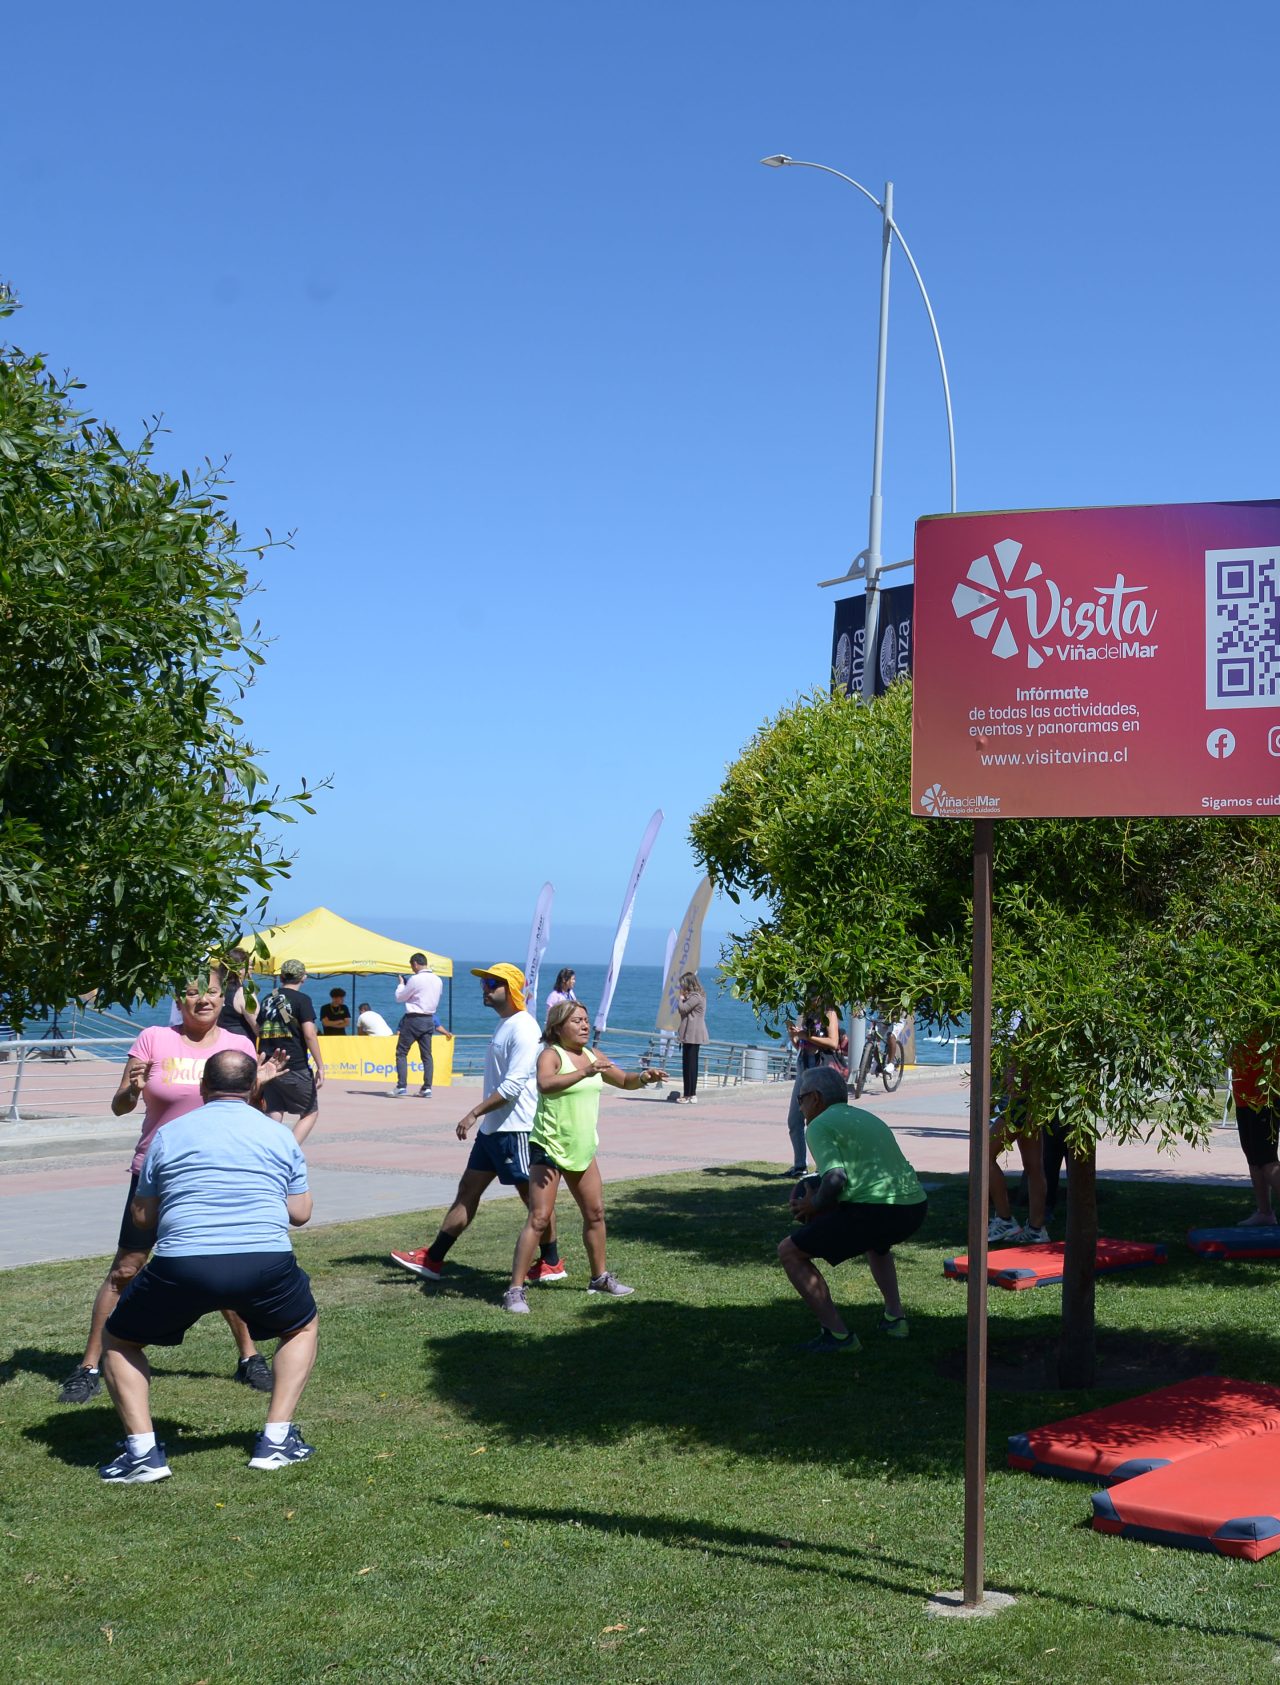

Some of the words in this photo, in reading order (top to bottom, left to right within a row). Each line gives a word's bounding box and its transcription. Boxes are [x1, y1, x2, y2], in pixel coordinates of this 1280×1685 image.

[1004, 573, 1158, 640] Visita
[1056, 641, 1158, 661] ViñadelMar
[851, 627, 865, 708] anza
[1016, 685, 1089, 702] Infórmate
[969, 707, 986, 721] de
[989, 705, 1027, 720] todas
[1031, 704, 1050, 718] las
[1053, 702, 1140, 718] actividades,
[969, 722, 1023, 736] eventos
[1026, 724, 1034, 737] y
[1037, 720, 1119, 737] panoramas
[1122, 720, 1140, 732] en
[980, 747, 1128, 766] www.visitavina.cl
[940, 807, 966, 815] Municipio
[1201, 796, 1253, 811] Sigamos
[364, 1060, 425, 1078] Depte
